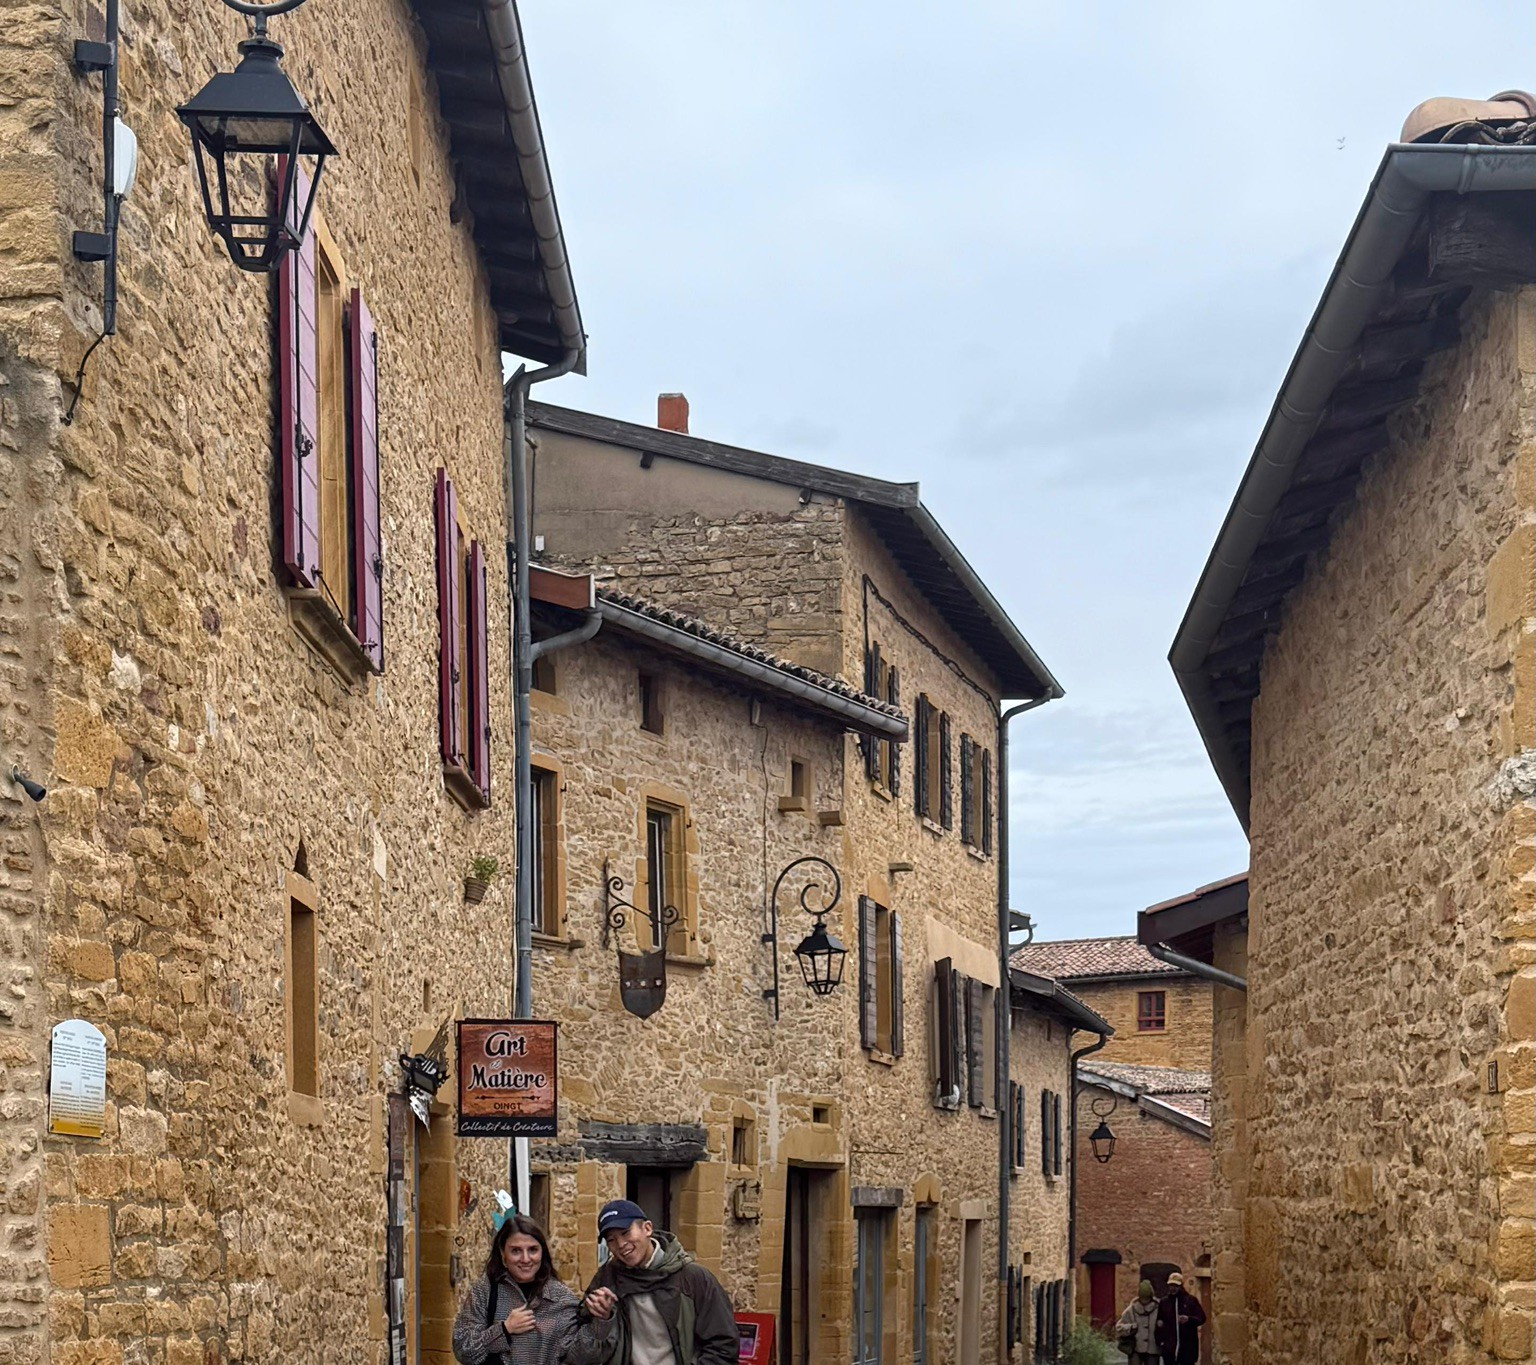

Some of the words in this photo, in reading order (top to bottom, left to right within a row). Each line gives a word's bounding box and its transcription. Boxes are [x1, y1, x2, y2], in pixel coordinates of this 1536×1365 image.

[468, 1064, 547, 1089] Matière
[493, 1102, 522, 1110] OINGT
[460, 1121, 500, 1132] Collectif
[501, 1122, 512, 1131] de
